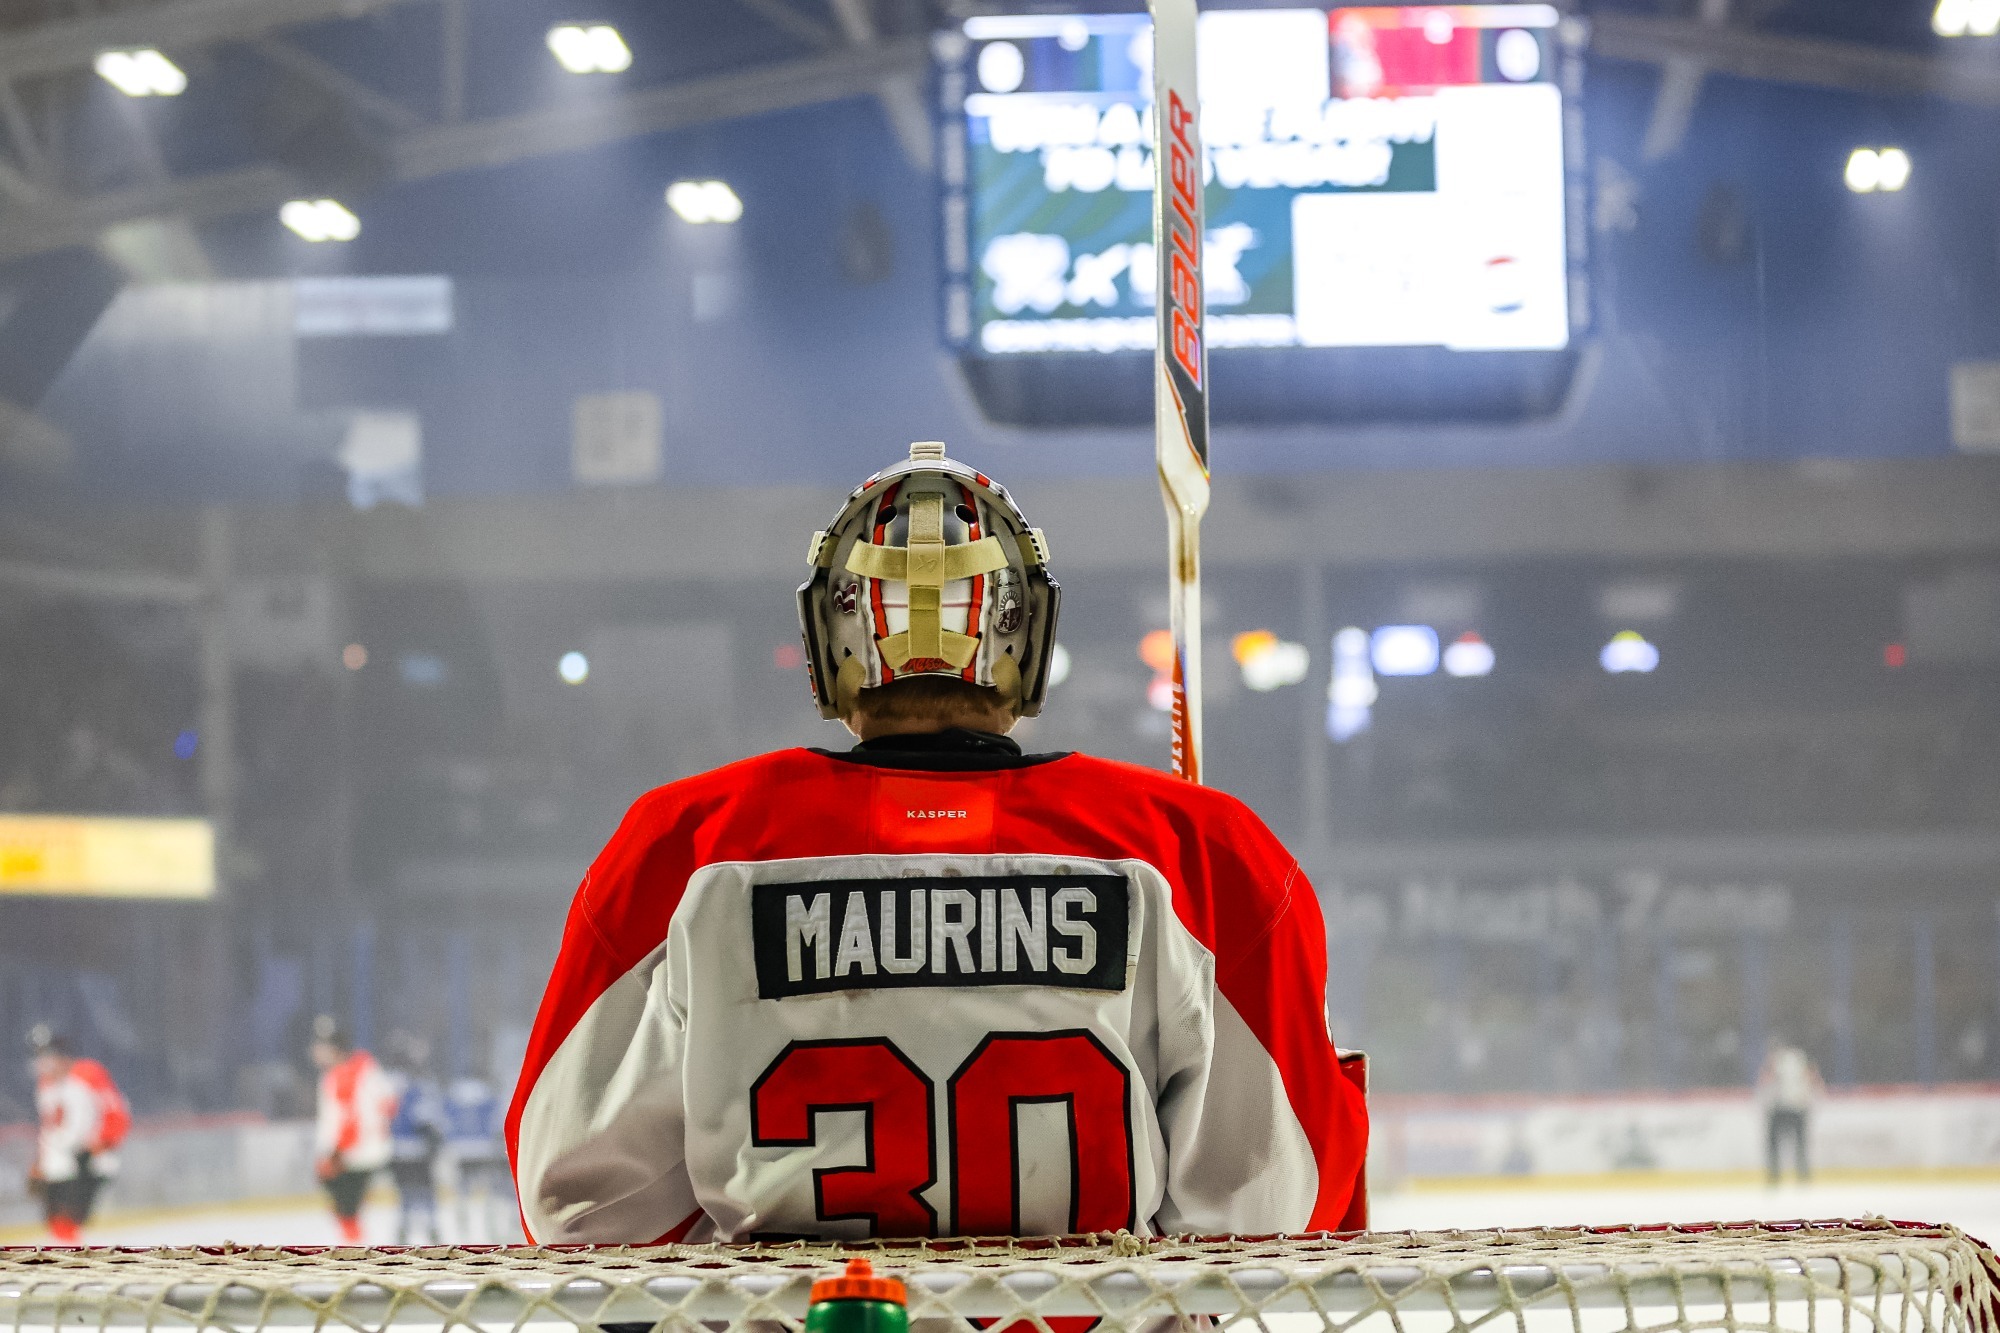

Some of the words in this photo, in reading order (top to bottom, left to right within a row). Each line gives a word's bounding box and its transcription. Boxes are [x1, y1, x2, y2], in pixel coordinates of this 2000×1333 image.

[1168, 88, 1202, 389] BAUER
[906, 809, 967, 819] KASPER
[785, 887, 1097, 982] MAURINS
[750, 1029, 1136, 1238] 30
